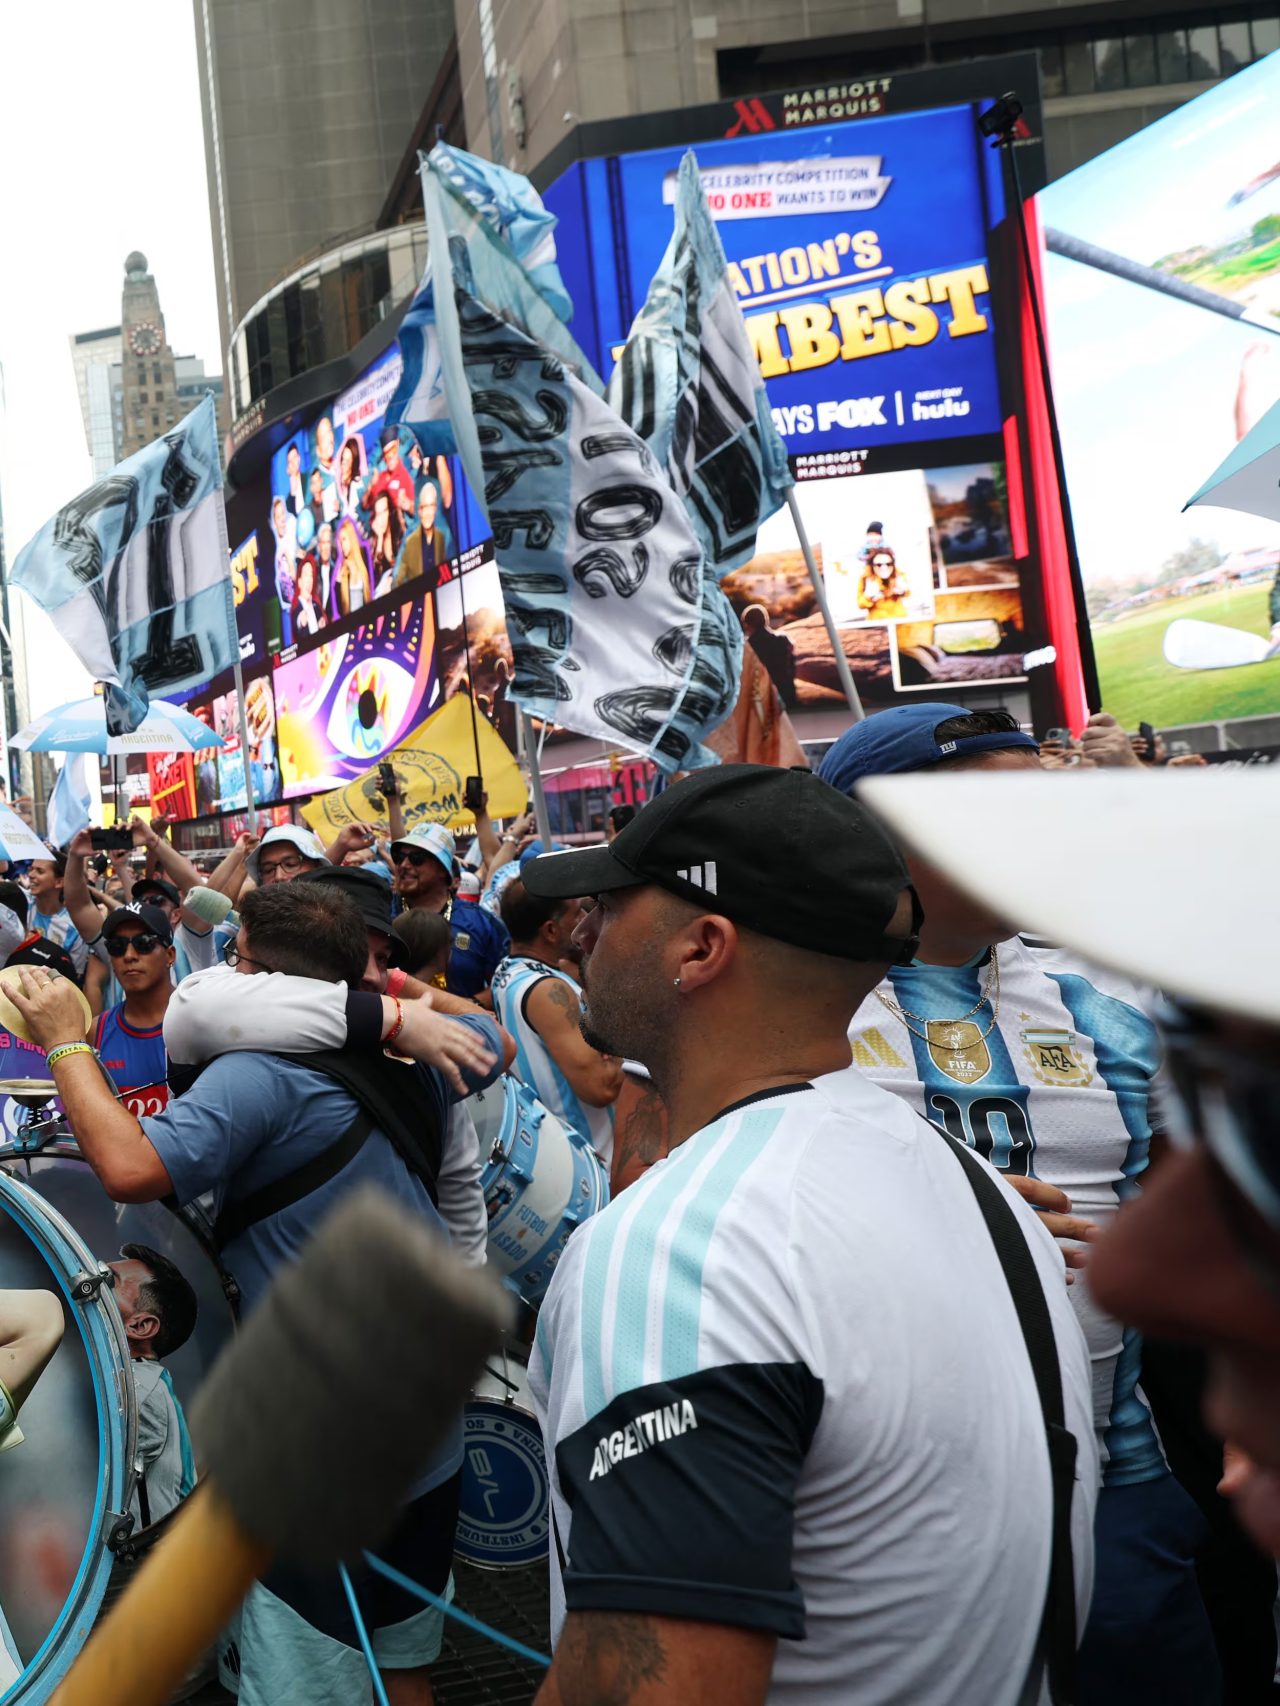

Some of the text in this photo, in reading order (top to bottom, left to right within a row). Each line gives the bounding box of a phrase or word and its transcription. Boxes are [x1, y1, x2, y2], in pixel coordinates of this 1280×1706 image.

[782, 77, 893, 108] MARRIOTT
[784, 97, 883, 125] MARQUIS
[700, 167, 870, 190] CELEBRITY COMPETITION
[731, 190, 772, 210] ONE
[777, 190, 825, 206] WANTS
[828, 190, 847, 204] TO
[851, 185, 879, 202] WIN
[726, 229, 883, 297] ATION'S
[770, 396, 888, 436] AYS FOX
[912, 397, 971, 422] hulu
[795, 449, 869, 467] MARRIOTT
[796, 461, 863, 479] MARQUIS
[451, 543, 484, 567] MRRIOTT
[16, 1036, 48, 1057] HIN
[1039, 1045, 1079, 1073] AFA
[948, 1060, 978, 1070] FIFA
[930, 1093, 1035, 1178] 10
[515, 1203, 550, 1237] FÚTBOL
[490, 1230, 529, 1263] ASADO
[589, 1398, 698, 1481] ARGENTINA
